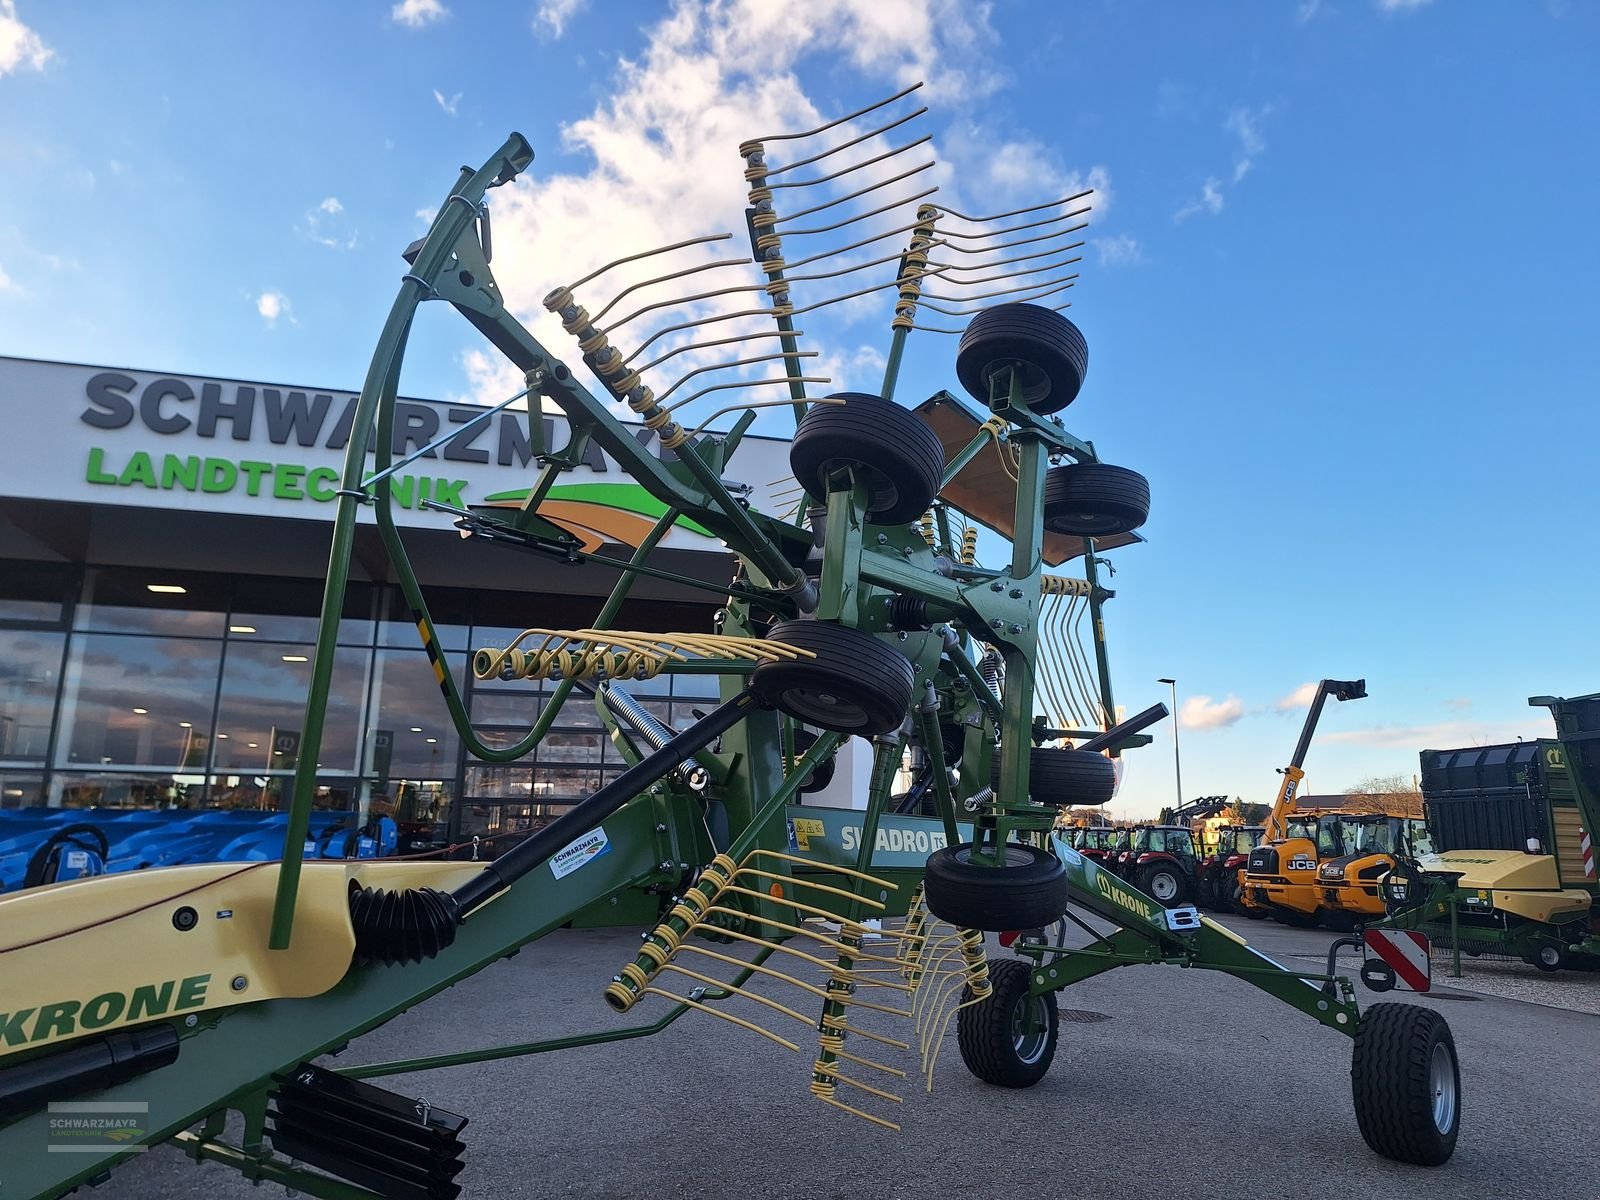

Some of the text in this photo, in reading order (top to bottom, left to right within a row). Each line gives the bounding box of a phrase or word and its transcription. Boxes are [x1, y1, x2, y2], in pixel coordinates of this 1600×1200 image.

[1284, 780, 1296, 803] JCB
[554, 836, 599, 863] SCHWARZMAYR
[1287, 860, 1316, 870] JCB
[1325, 866, 1339, 875] JCB
[1111, 886, 1151, 920] KRONE
[0, 973, 212, 1046] KRONE
